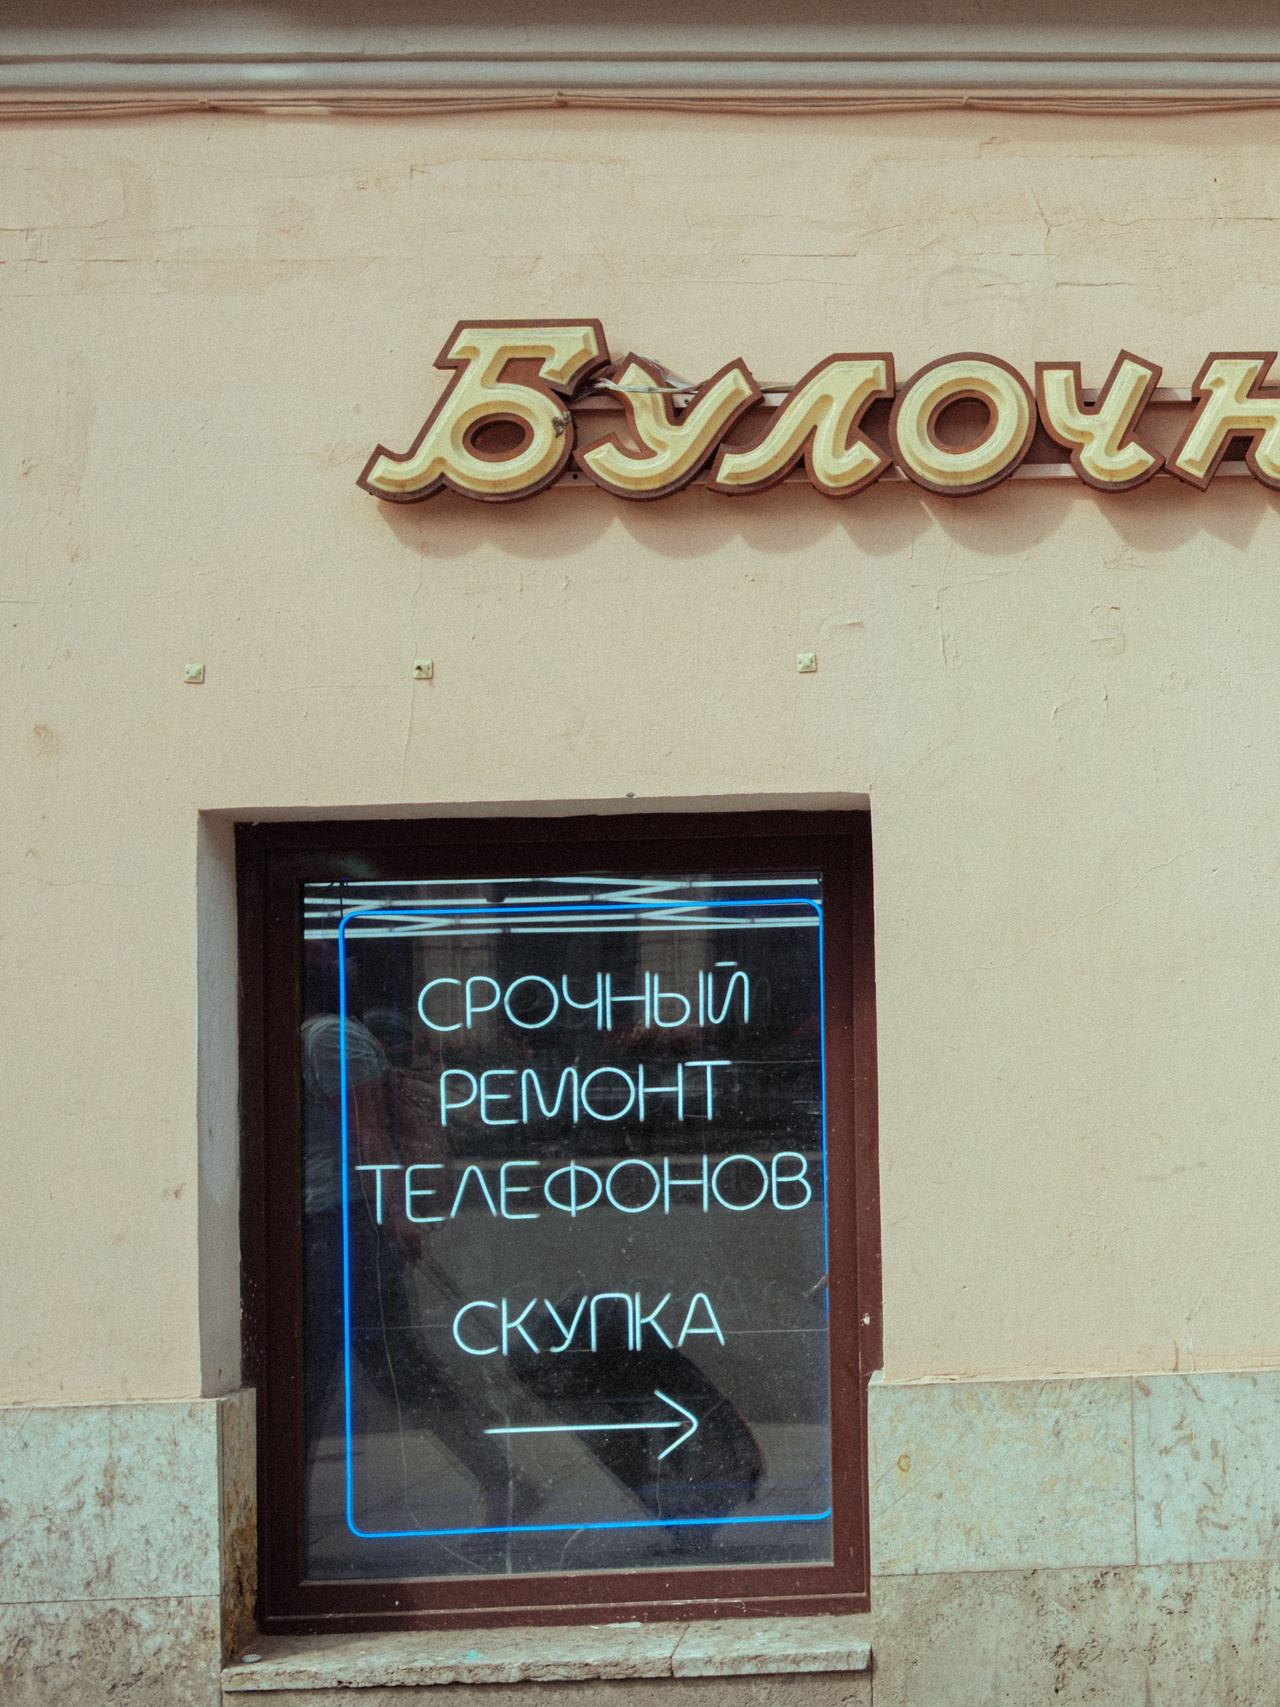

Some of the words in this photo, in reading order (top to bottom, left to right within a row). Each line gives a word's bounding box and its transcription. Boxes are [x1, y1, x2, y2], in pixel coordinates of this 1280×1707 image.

[417, 960, 750, 1031] СРОЧНЫЙ
[440, 1060, 732, 1127] РЕМОНТ
[355, 1151, 813, 1226] ТЕЛЕФОНОВ
[452, 1291, 726, 1356] СКУПКА
